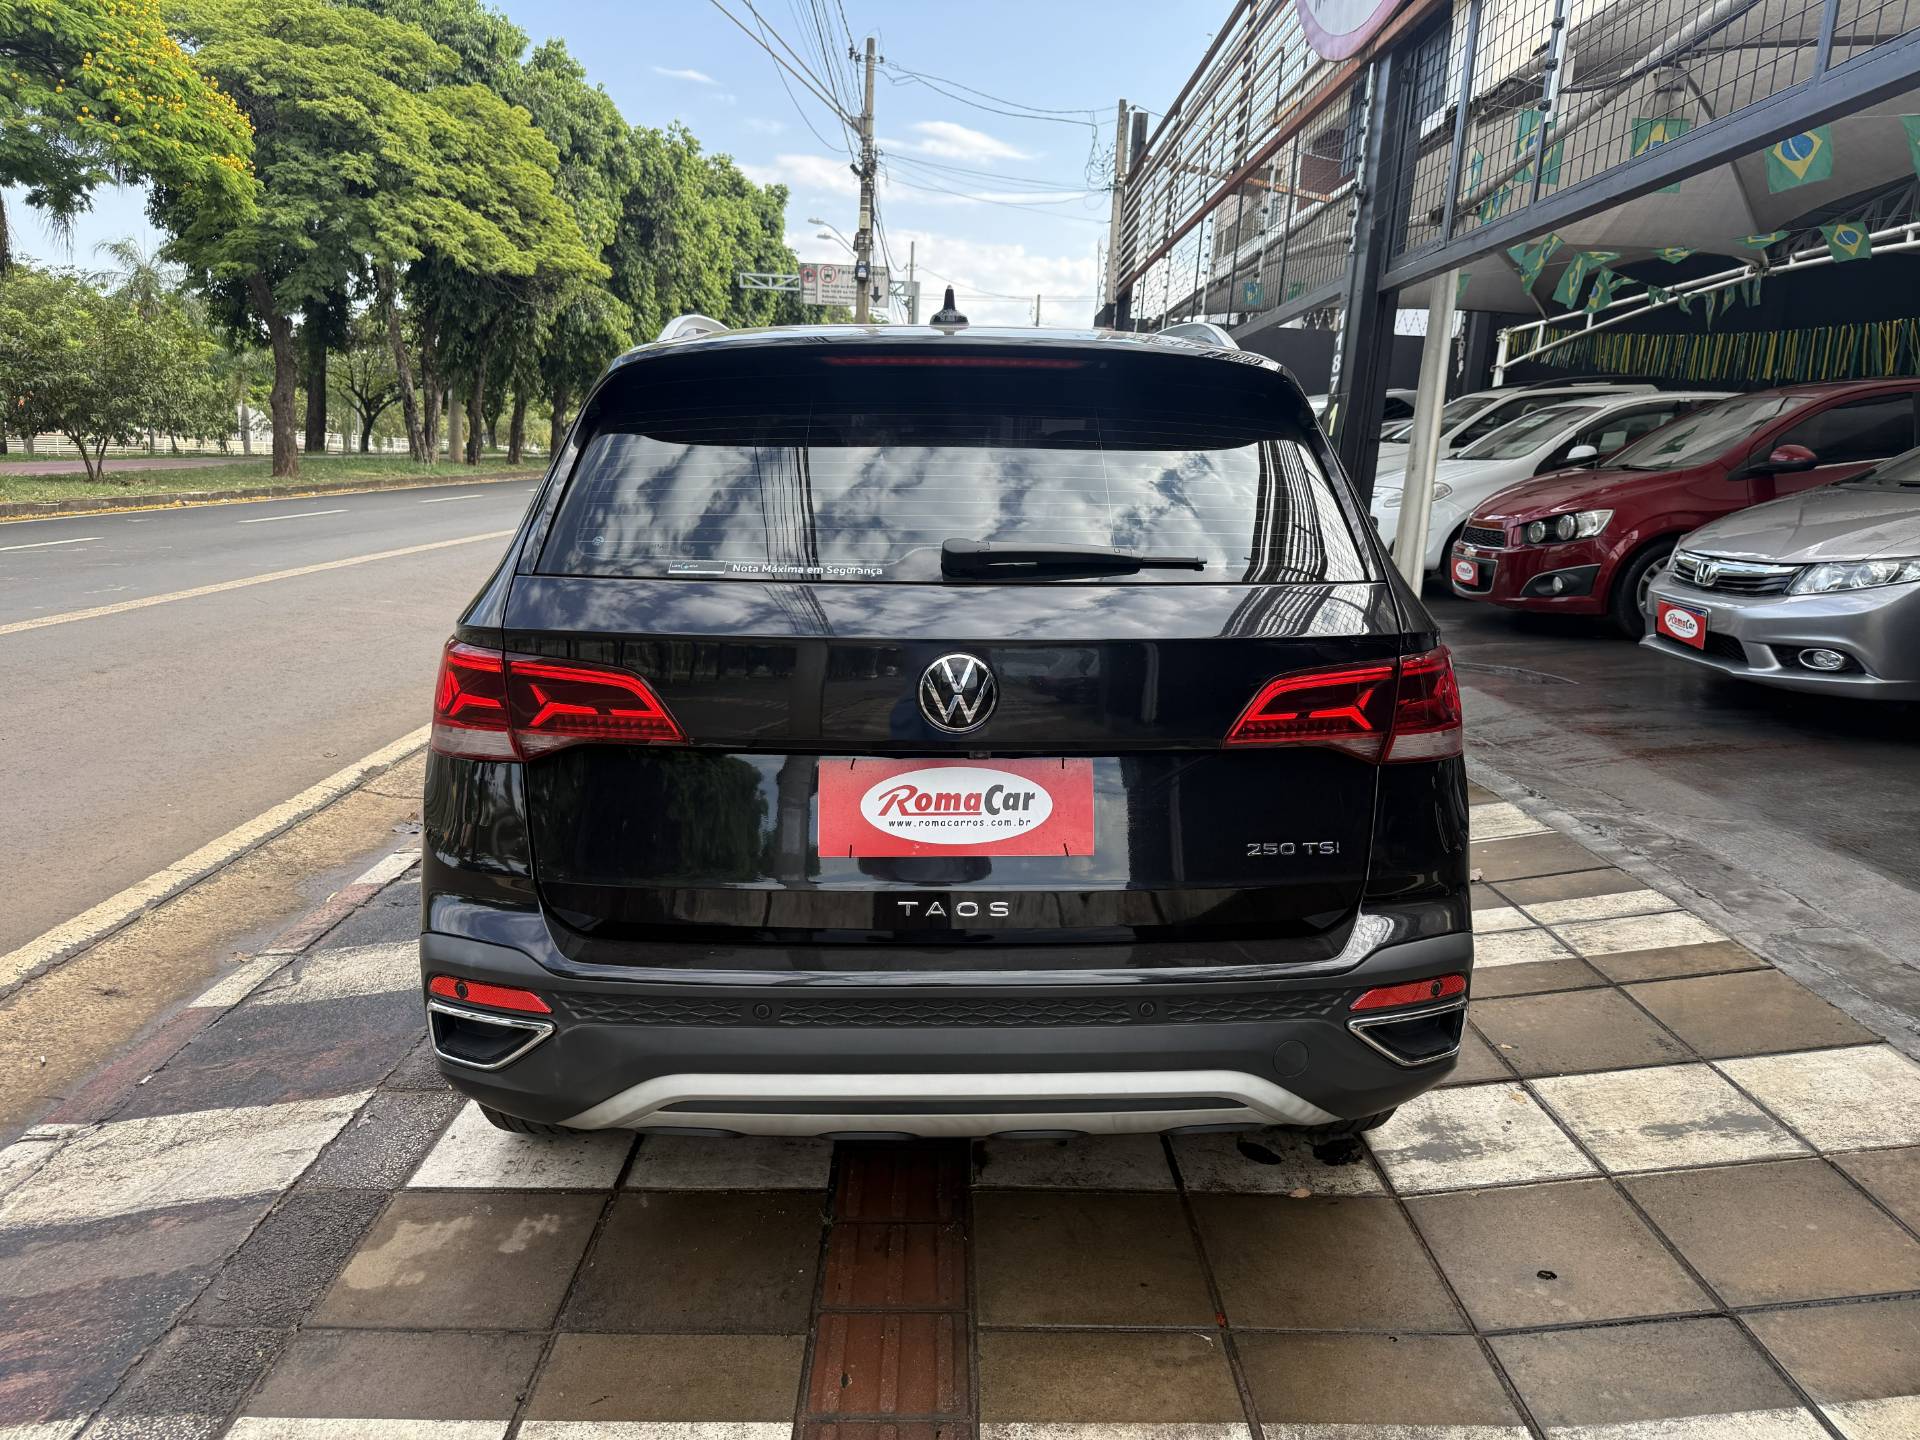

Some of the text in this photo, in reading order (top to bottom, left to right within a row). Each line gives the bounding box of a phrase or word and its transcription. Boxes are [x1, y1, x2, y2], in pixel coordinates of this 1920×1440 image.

[732, 563, 883, 577] Nota Máxima em Segurança
[878, 784, 1036, 816] RomaCar
[888, 818, 1031, 828] www.romacarros.com.br
[1247, 841, 1340, 856] 250 TSI
[897, 901, 1009, 917] TAOS
